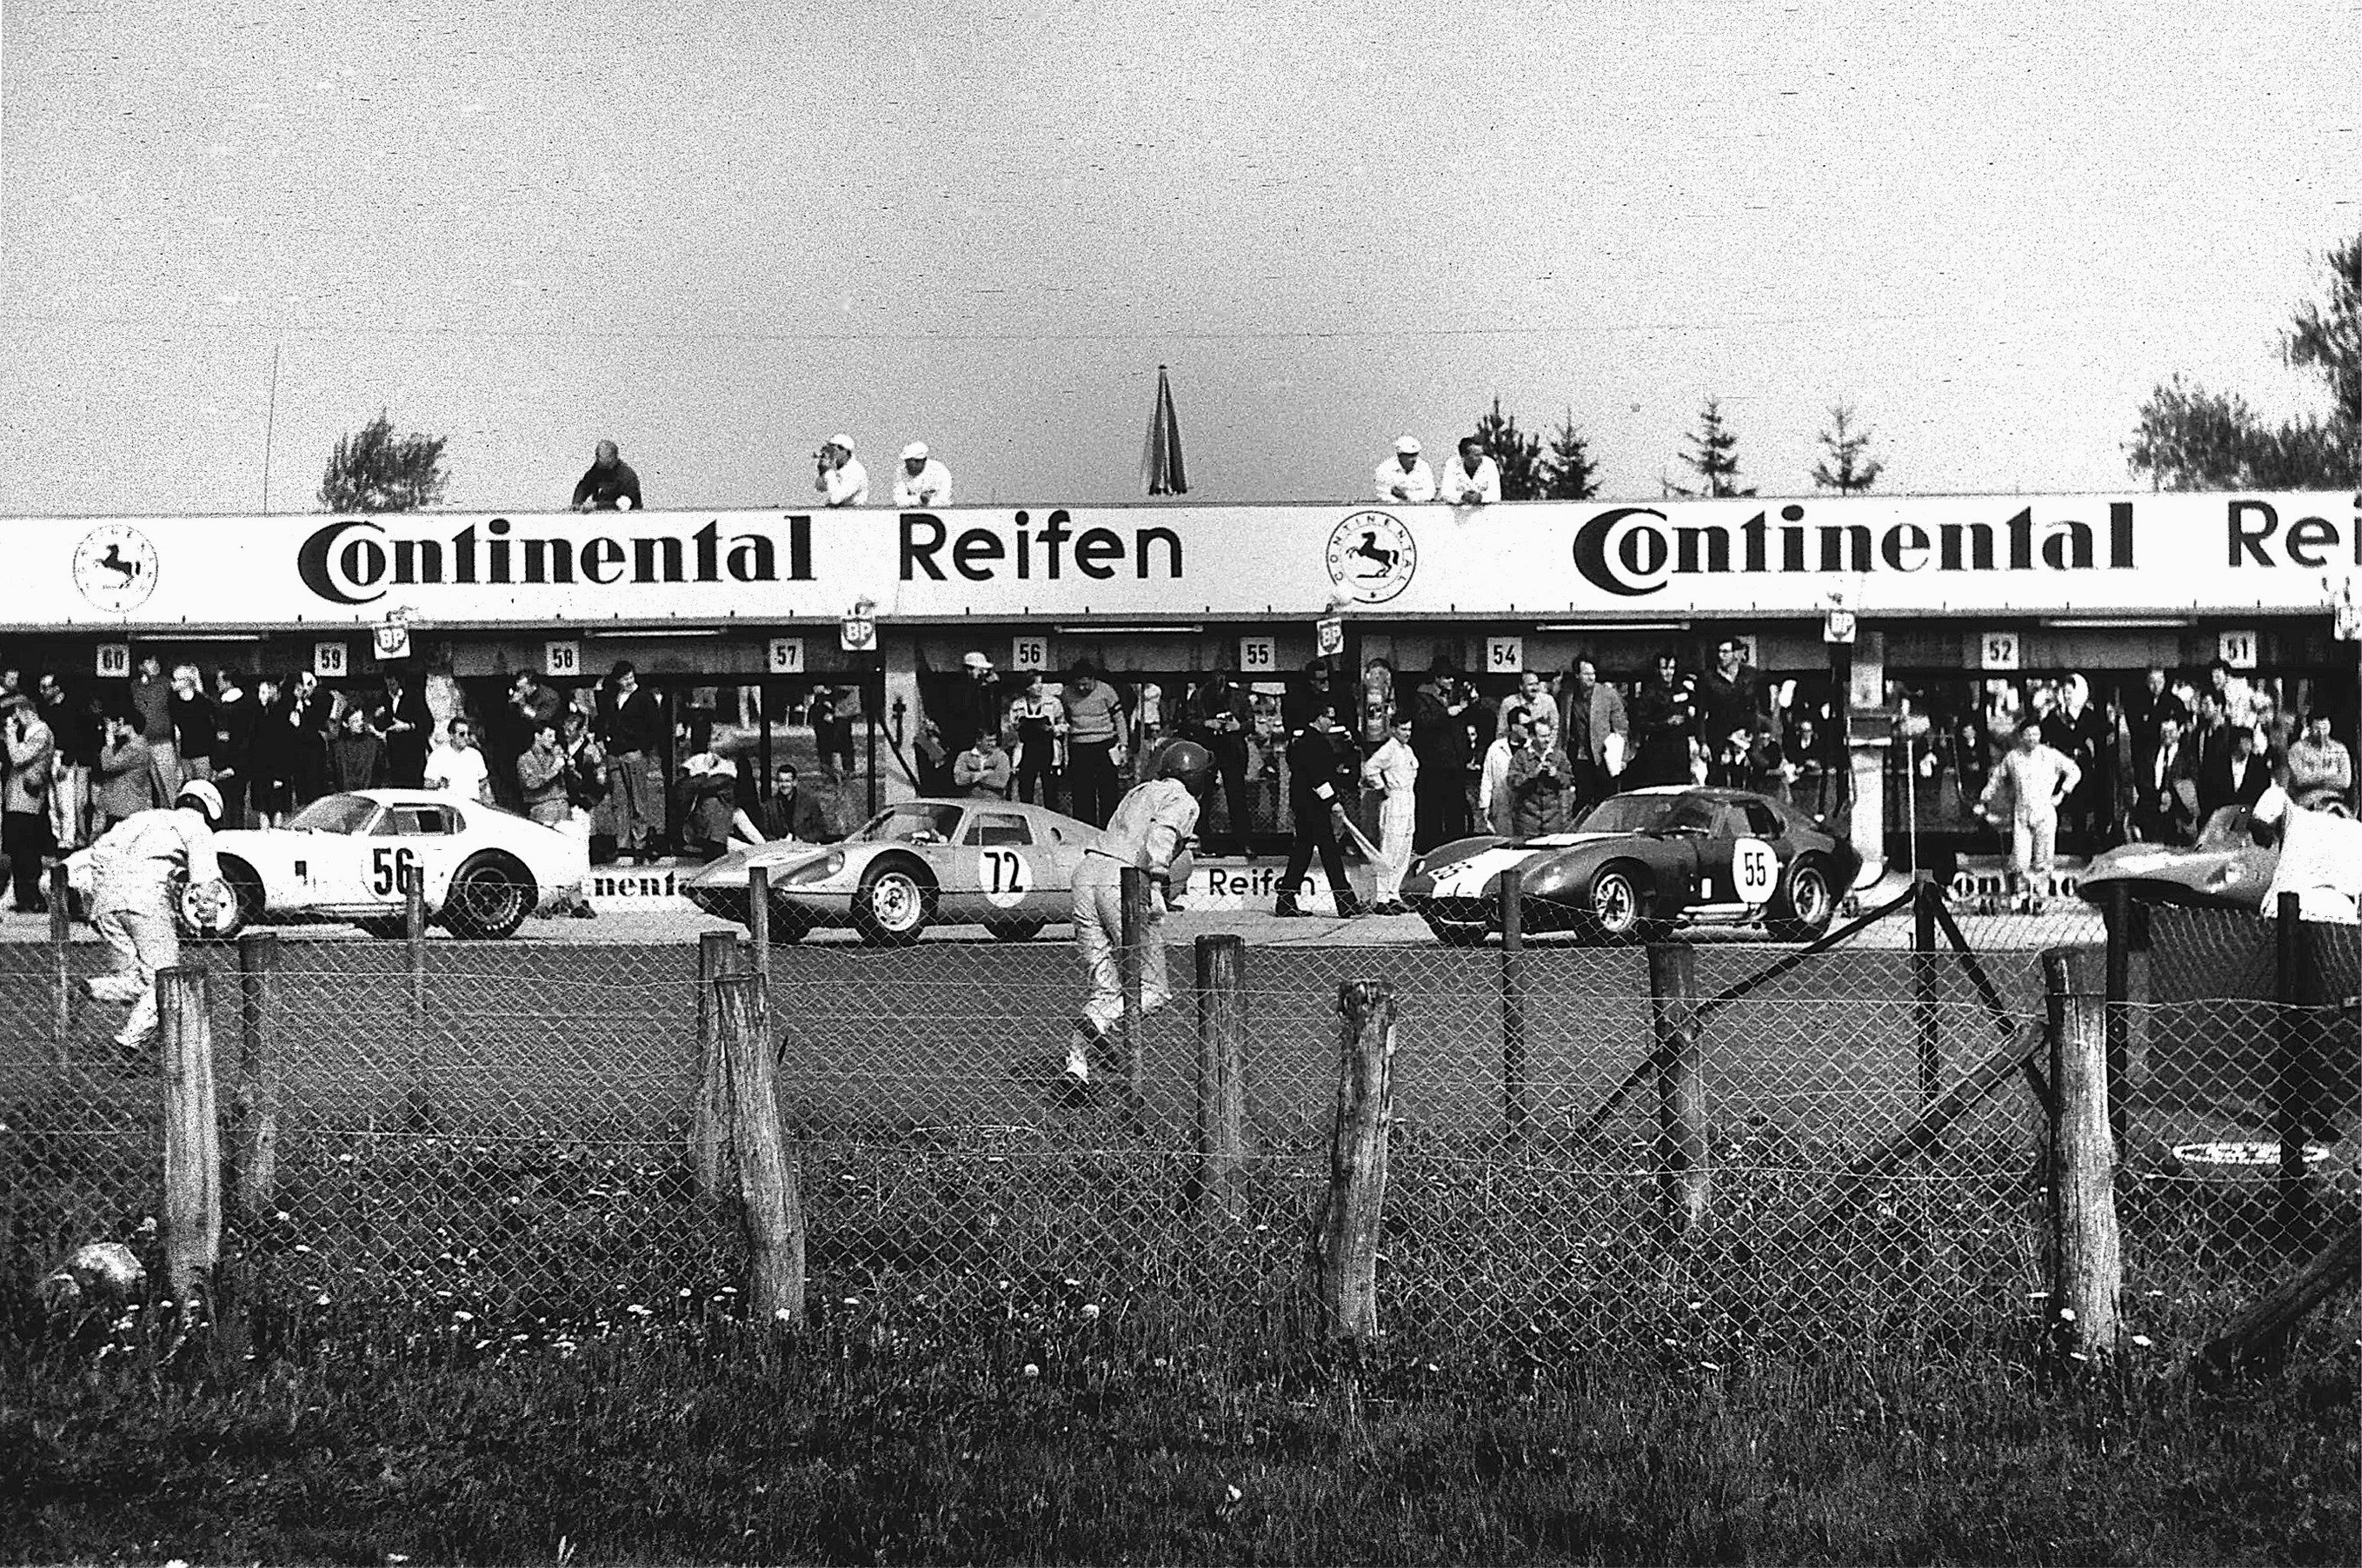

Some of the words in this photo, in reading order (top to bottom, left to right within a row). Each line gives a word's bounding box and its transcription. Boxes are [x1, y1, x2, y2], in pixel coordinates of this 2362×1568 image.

[297, 515, 818, 606] Continental
[899, 509, 1183, 581] Reifen
[1573, 503, 2138, 597] Continental
[378, 628, 406, 649] BP
[846, 621, 873, 641] BP
[1321, 624, 1341, 647] BP
[321, 648, 341, 669] 59
[552, 648, 573, 668] 58
[776, 645, 796, 666] 57
[1020, 643, 1041, 664] 56
[1247, 644, 1269, 665] 55
[1494, 644, 1516, 665] 54
[1990, 641, 2012, 661] 52
[2227, 638, 2248, 661] 51
[373, 847, 415, 895] 56
[983, 852, 1023, 894] 72
[1743, 852, 1767, 887] 55
